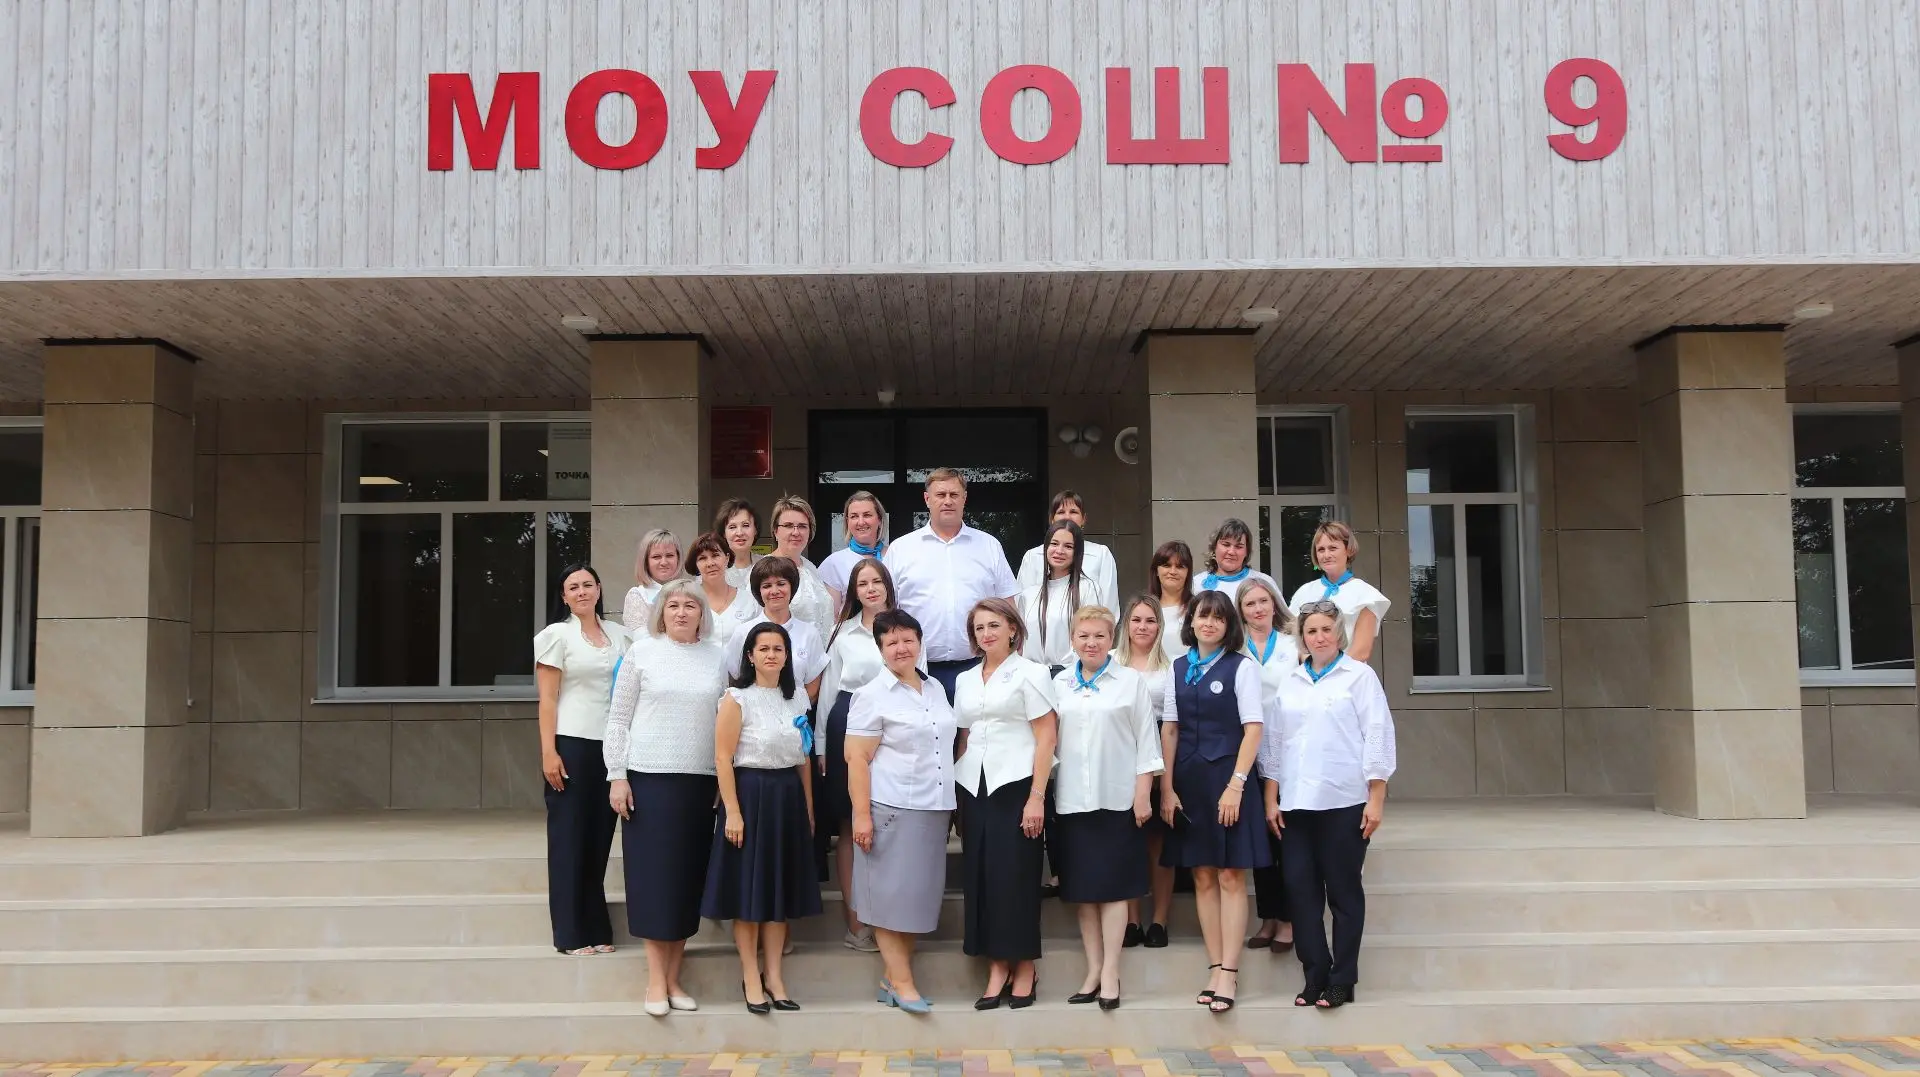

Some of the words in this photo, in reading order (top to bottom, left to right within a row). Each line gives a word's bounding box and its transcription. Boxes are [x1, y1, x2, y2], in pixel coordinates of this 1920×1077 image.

[427, 68, 778, 171] МОУ
[859, 63, 1230, 168] СОШ
[1277, 62, 1449, 164] №
[1544, 57, 1628, 161] 9
[554, 471, 590, 480] ТОЧКА
